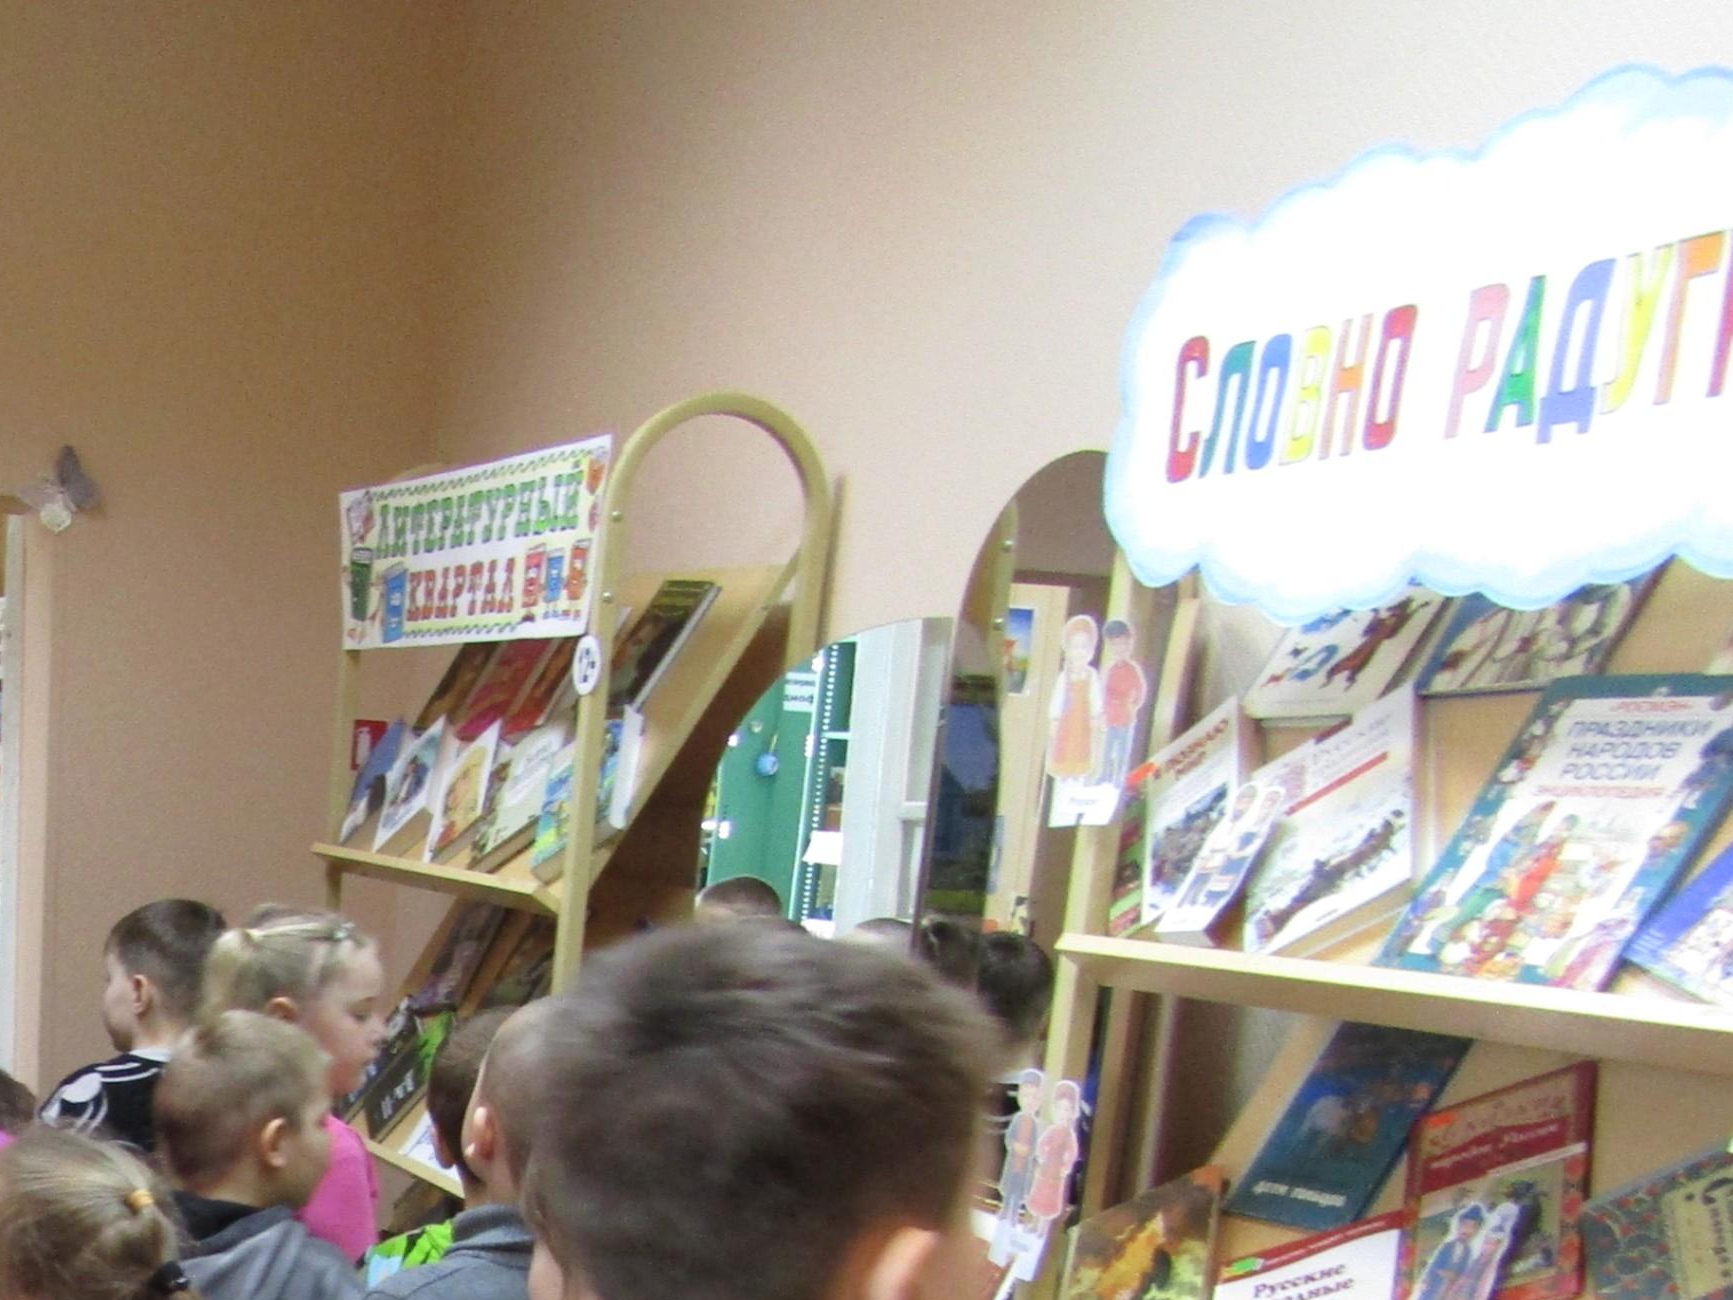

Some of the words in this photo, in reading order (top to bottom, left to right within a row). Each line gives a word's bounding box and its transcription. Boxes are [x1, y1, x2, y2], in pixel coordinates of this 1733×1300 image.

[1165, 303, 1418, 484] СЛОВНО
[405, 556, 516, 622] КВАРТАЛ
[1568, 719, 1714, 738] ПРАЗДНИКИ
[1567, 741, 1682, 759] НАРОДОВ
[1559, 762, 1662, 781] РОССИИ
[1253, 1263, 1346, 1299] Русские
